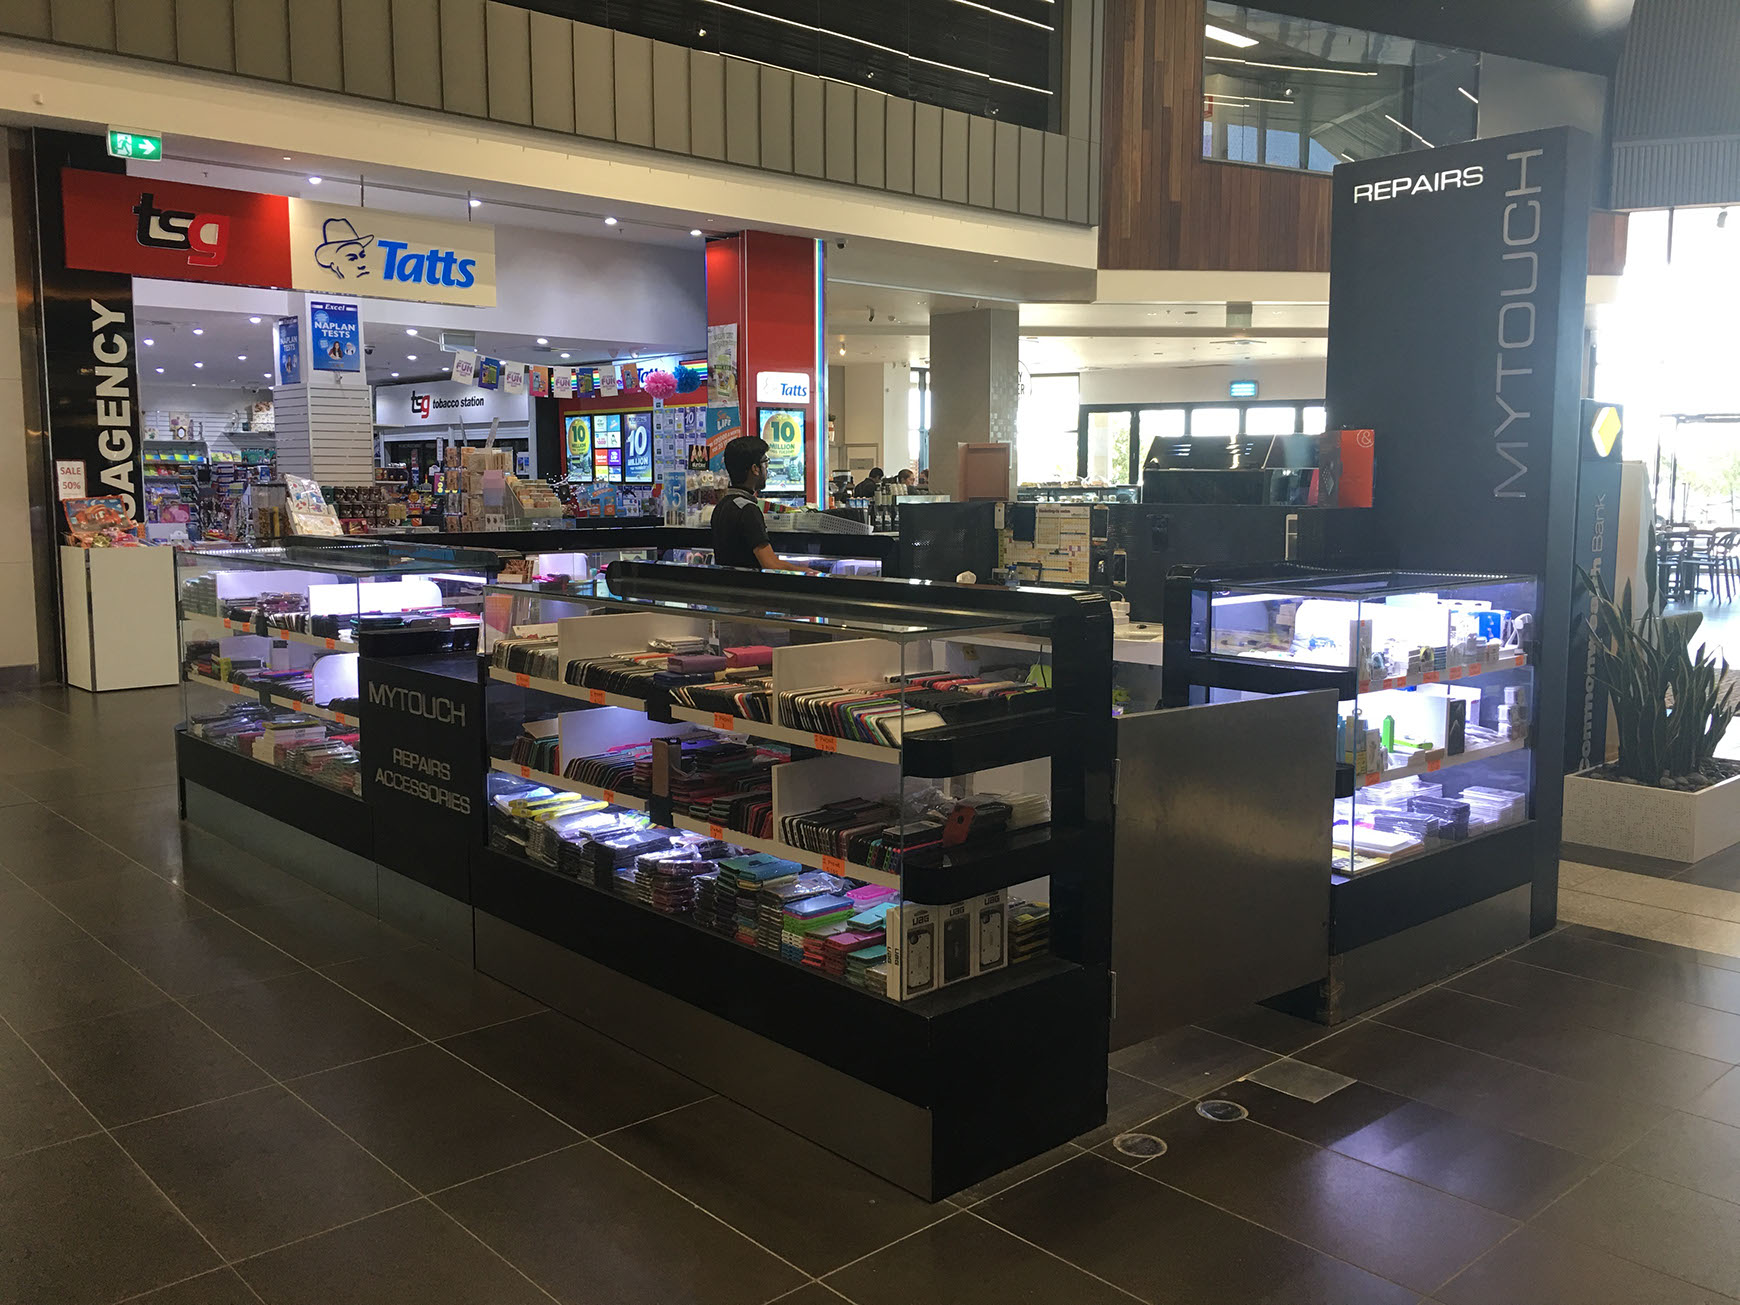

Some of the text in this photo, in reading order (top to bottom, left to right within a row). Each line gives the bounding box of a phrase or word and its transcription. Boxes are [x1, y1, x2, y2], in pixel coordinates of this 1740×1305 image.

[1353, 166, 1484, 204] REPAIRS
[132, 192, 230, 267] tsg
[377, 240, 476, 289] Tatts
[314, 321, 356, 332] NAPLAN
[1494, 149, 1544, 498] MYTOUCH
[280, 335, 298, 345] NAPLAN
[321, 329, 351, 338] TESTS
[283, 344, 296, 352] TESTS
[456, 362, 473, 373] FUN
[506, 374, 522, 384] FUN
[555, 378, 571, 387] FUN
[601, 376, 616, 386] FUN
[780, 383, 807, 397] Tatts
[411, 390, 430, 419] tsg
[432, 395, 485, 409] tobacco station
[685, 411, 694, 425] 10
[571, 425, 586, 443] 10
[770, 421, 796, 443] 10
[626, 425, 648, 457] 10
[627, 456, 649, 466] MILLION
[60, 466, 82, 475] SALE
[62, 481, 82, 490] 50%
[1591, 494, 1606, 552] Bank
[368, 680, 466, 727] MYTOUCH
[392, 747, 451, 781] REPAIRS
[375, 767, 471, 815] ACCESSORIES
[949, 906, 965, 917] UAG
[912, 914, 930, 926] UAG
